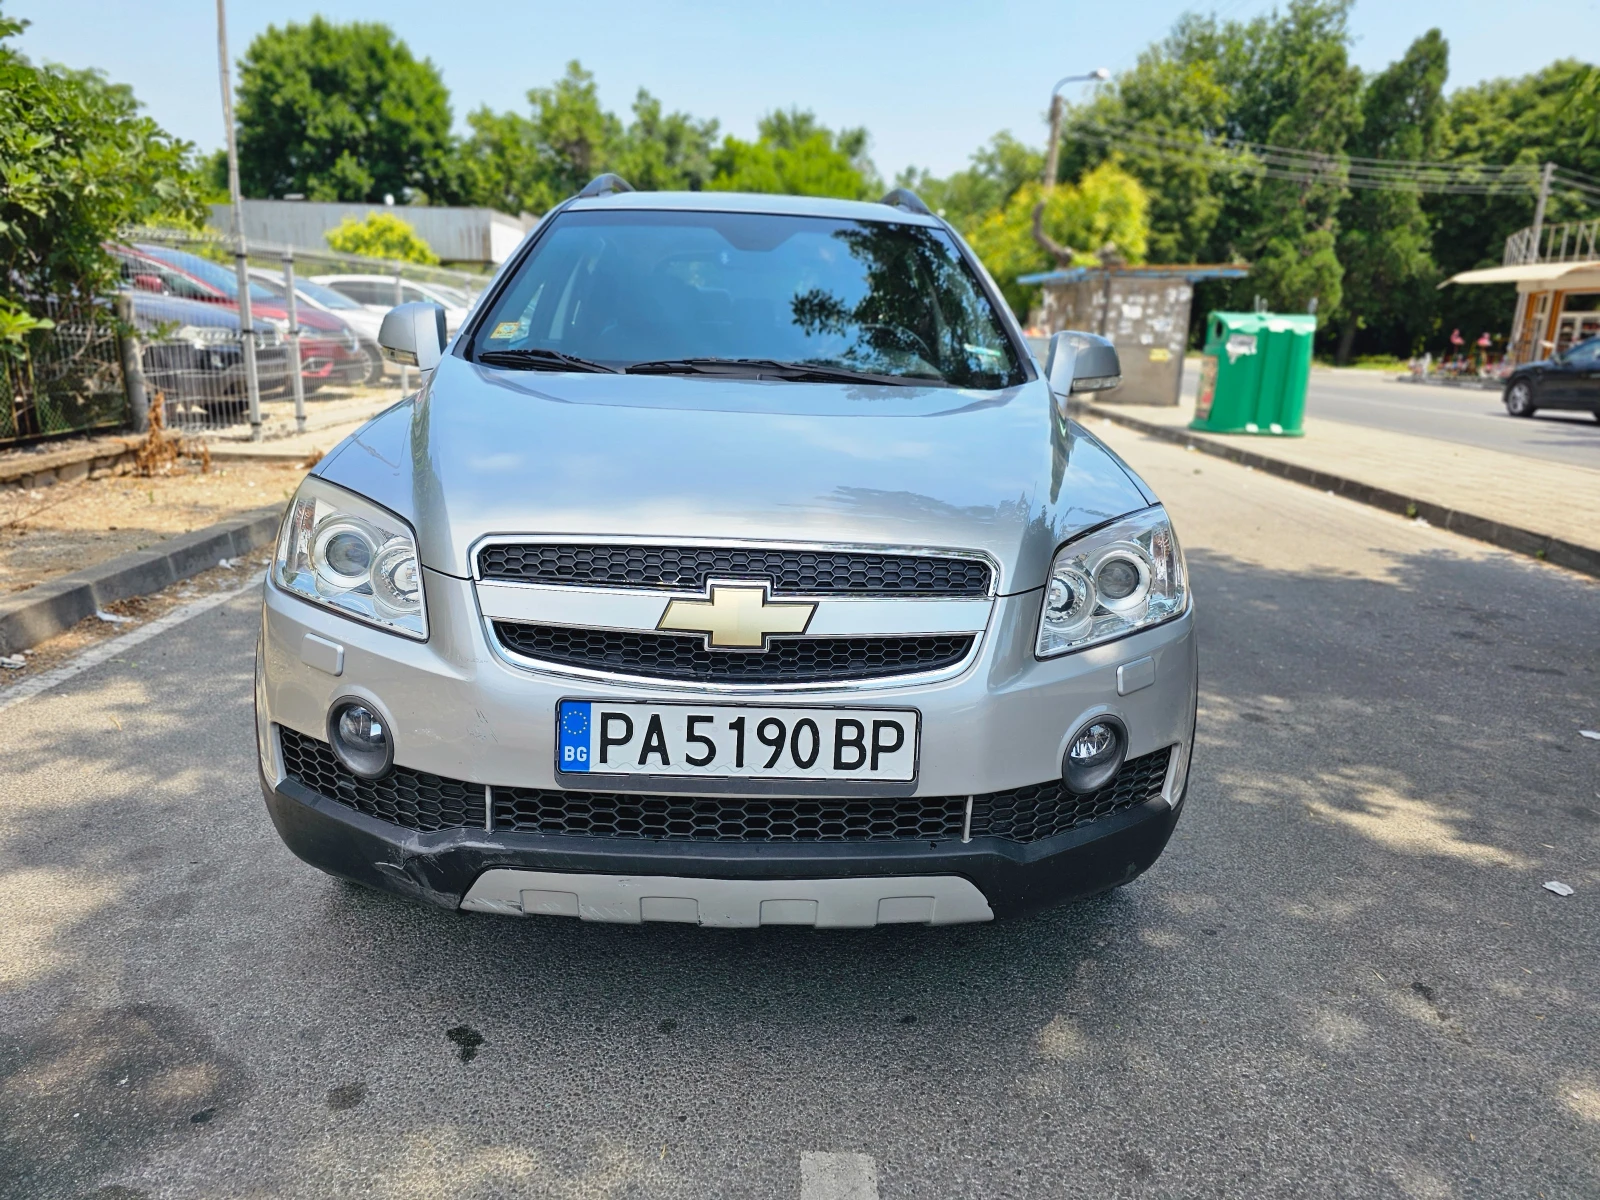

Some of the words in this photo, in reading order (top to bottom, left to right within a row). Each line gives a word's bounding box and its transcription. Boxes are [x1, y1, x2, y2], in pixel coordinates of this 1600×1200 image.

[564, 745, 588, 762] BG
[600, 711, 671, 766] PA
[685, 715, 820, 769] 5190
[833, 718, 905, 771] BP
